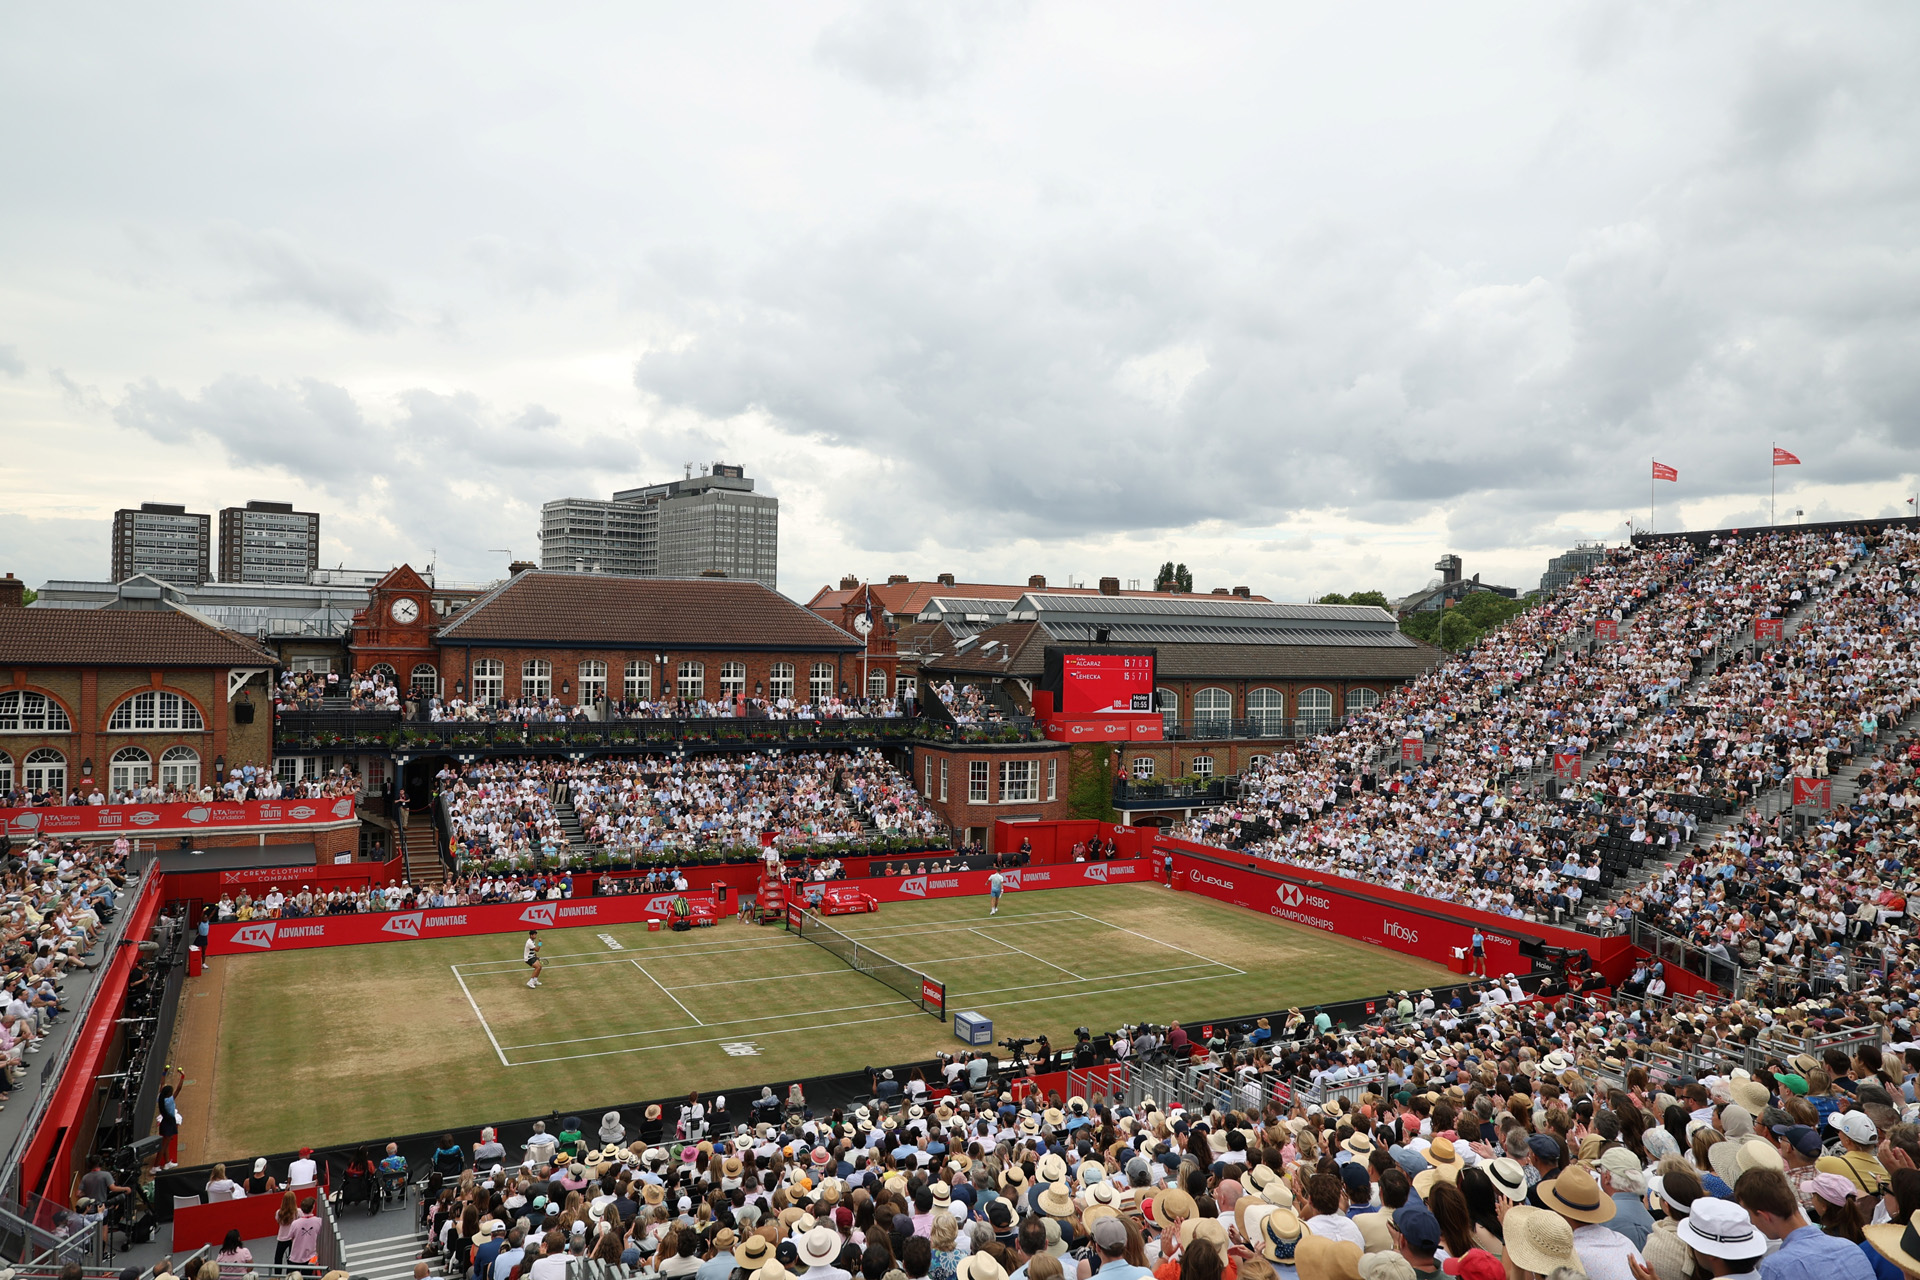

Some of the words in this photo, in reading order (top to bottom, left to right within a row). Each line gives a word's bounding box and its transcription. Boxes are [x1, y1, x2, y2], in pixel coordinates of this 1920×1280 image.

[1124, 659, 1130, 667] 15
[1132, 659, 1136, 667] 7
[1145, 659, 1149, 667] 3
[1124, 672, 1130, 680] 15
[1132, 672, 1136, 680] 5
[1138, 672, 1142, 680] 7
[213, 809, 228, 817] LTA
[260, 809, 282, 818] YOUTH
[98, 815, 122, 824] YOUTH
[271, 867, 314, 875] CLOTHING
[1109, 866, 1135, 875] ADVANTAGE
[1023, 872, 1051, 882] ADVANTAGE
[1202, 874, 1234, 890] LEXUS
[929, 878, 959, 890] ADVANTAGE
[1305, 894, 1330, 910] HSBC
[528, 909, 556, 921] LTA
[558, 905, 598, 918] ADVANTAGE
[1271, 905, 1334, 931] CHAMPIONSHIPS
[392, 919, 422, 932] LTA
[425, 914, 468, 928] ADVANTAGE
[241, 929, 273, 942] LTA
[278, 924, 325, 939] ADVANTAGE
[1383, 919, 1419, 943] Infosys
[1536, 960, 1553, 971] Haier
[923, 985, 942, 1002] Emirates
